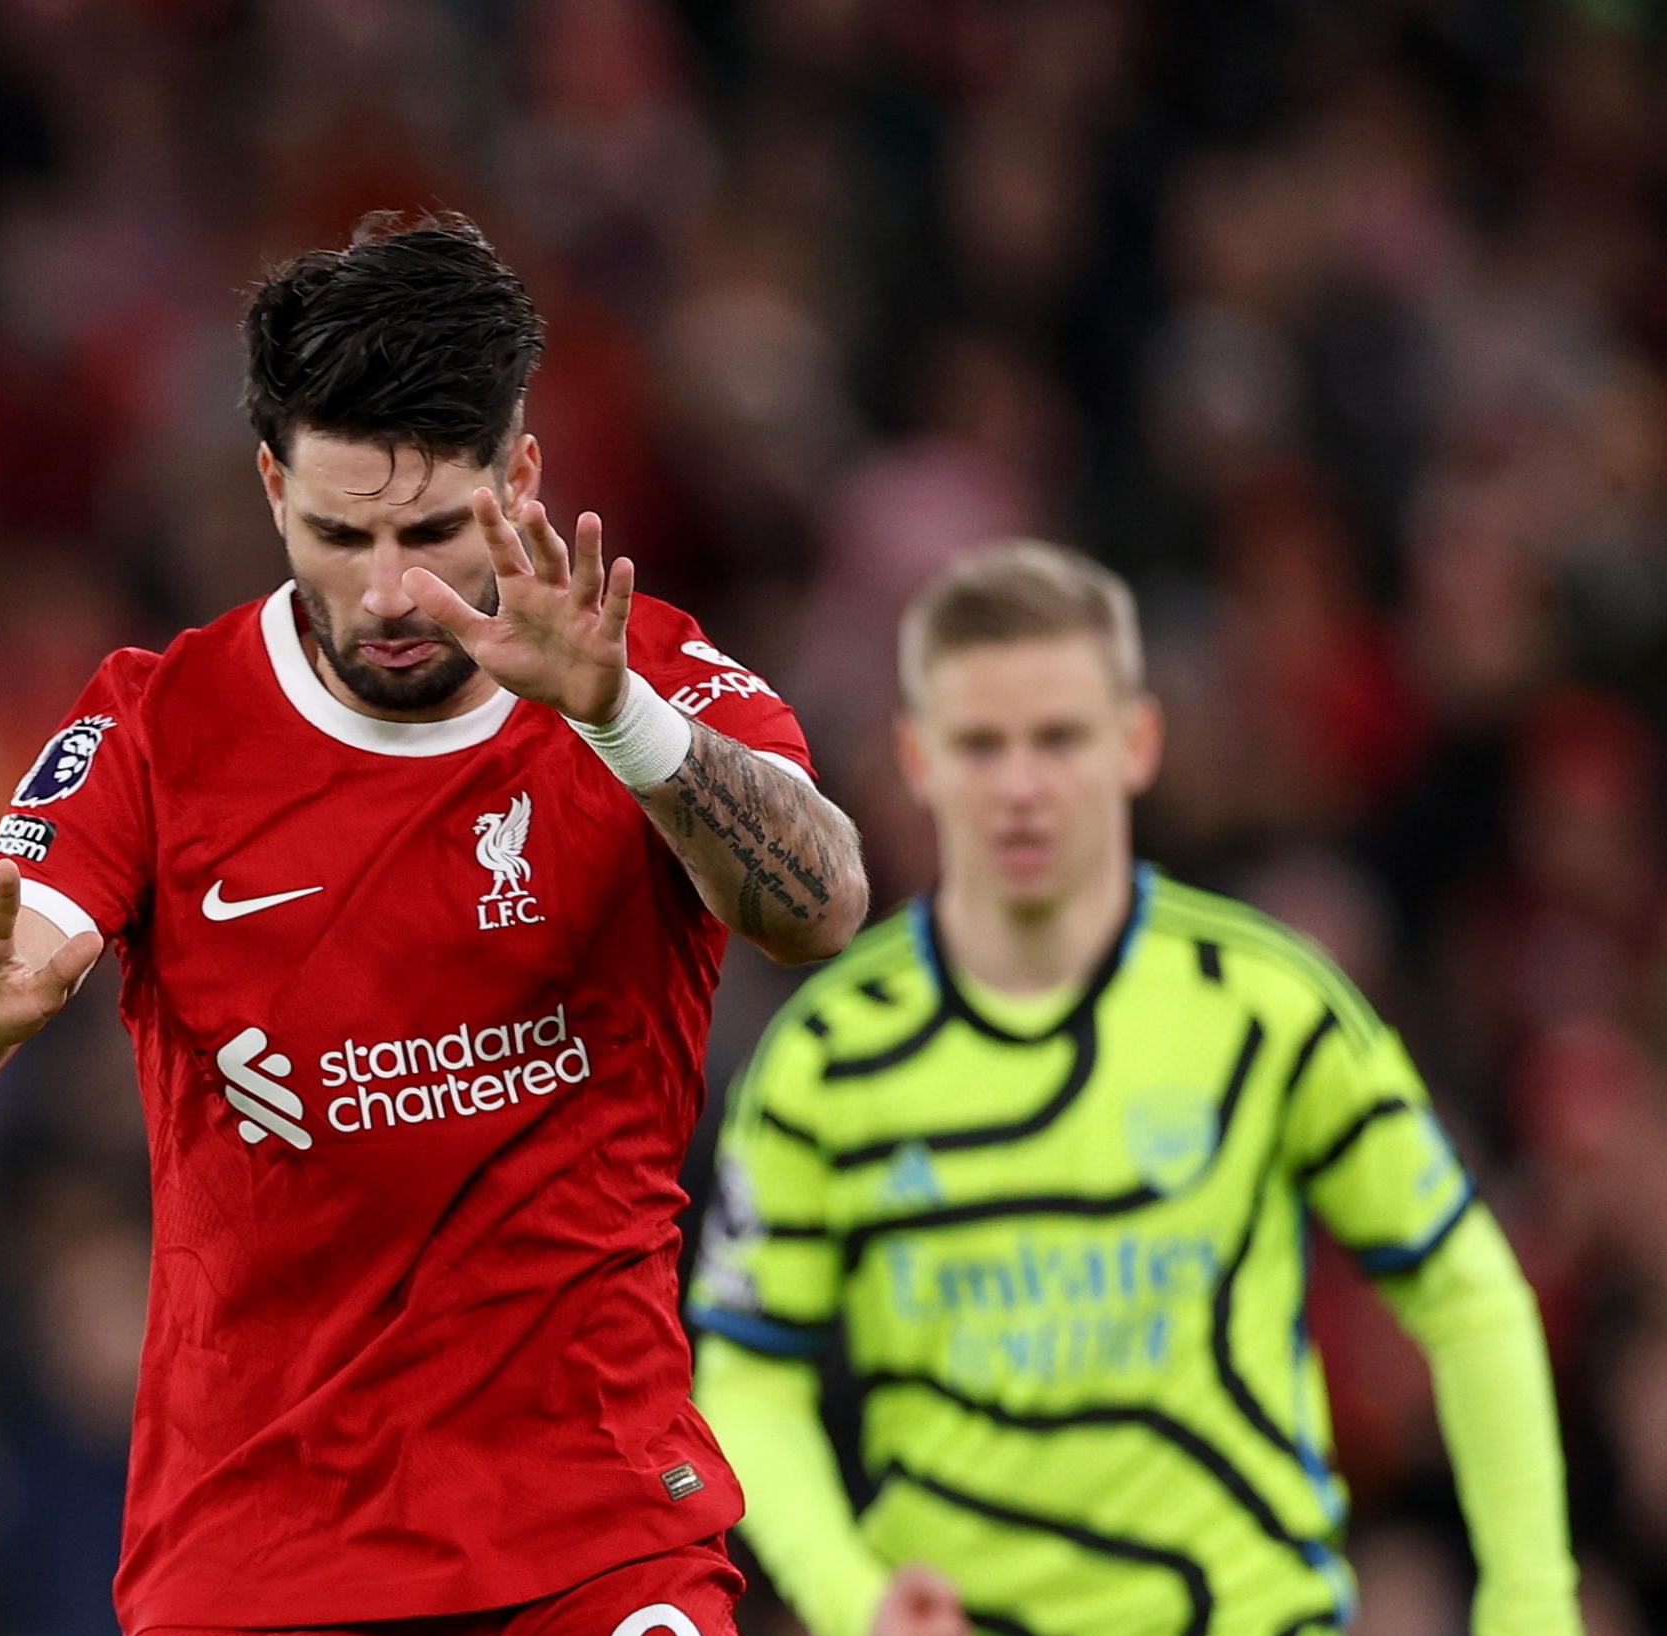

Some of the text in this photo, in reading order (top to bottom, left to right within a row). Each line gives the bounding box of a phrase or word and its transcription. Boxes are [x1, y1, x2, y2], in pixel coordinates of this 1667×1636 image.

[668, 671, 779, 716] Expe
[476, 897, 546, 930] L.F.C.
[320, 1003, 568, 1088] standard
[327, 1036, 591, 1134] chartered
